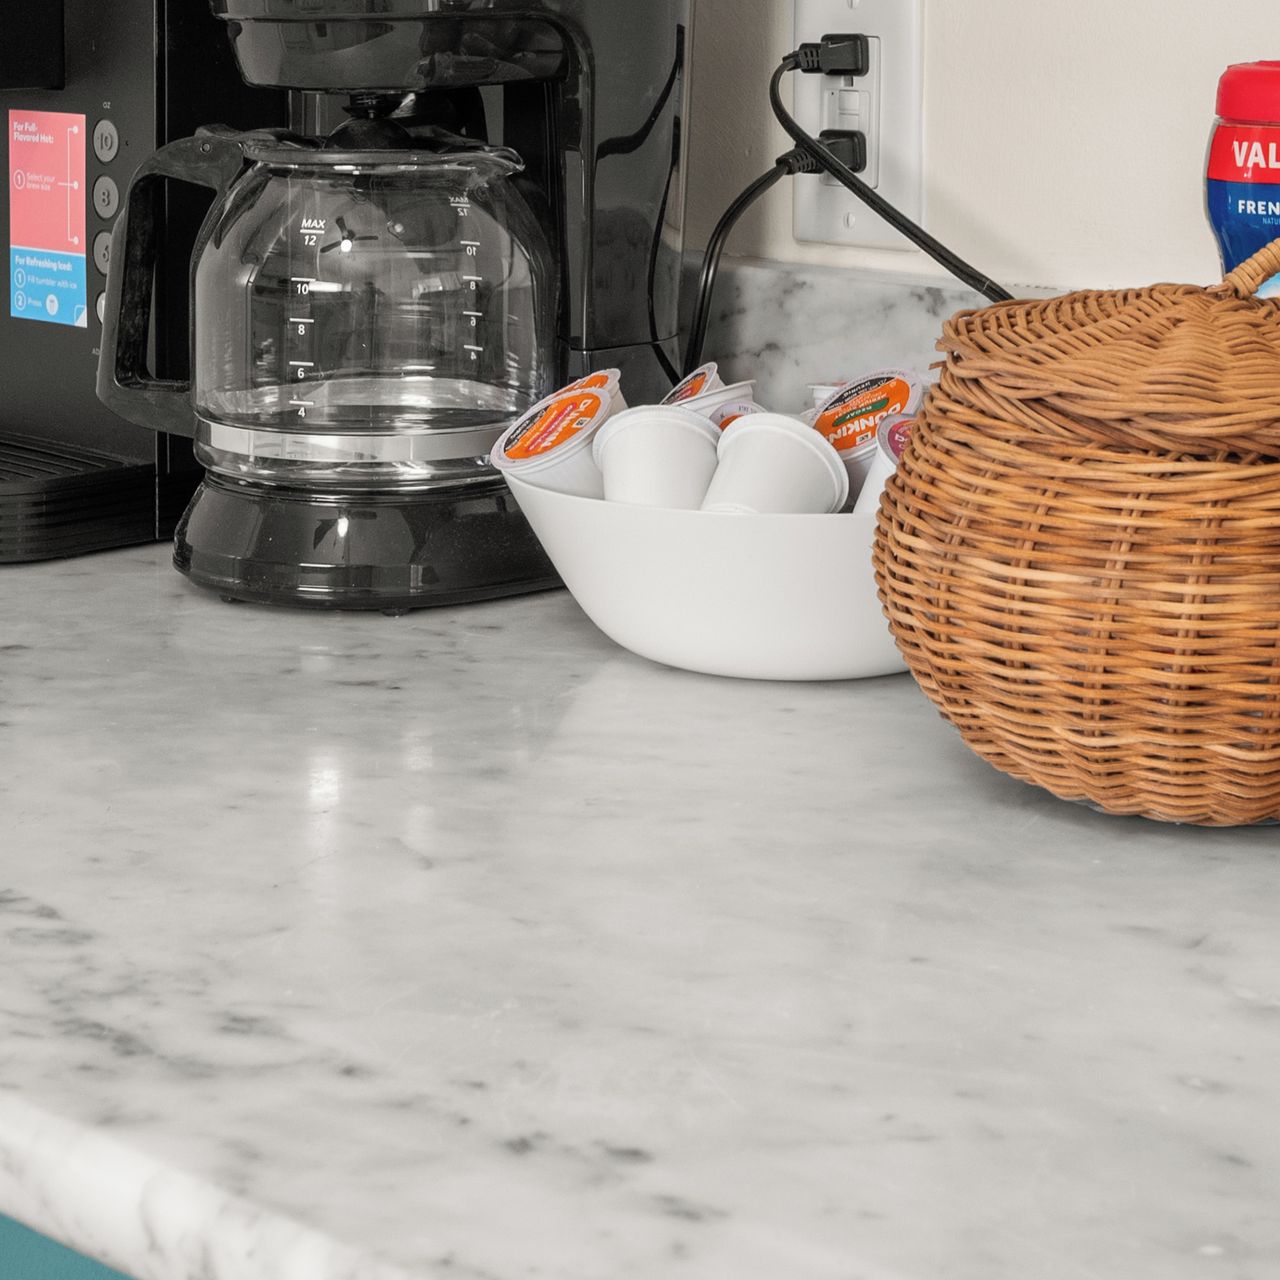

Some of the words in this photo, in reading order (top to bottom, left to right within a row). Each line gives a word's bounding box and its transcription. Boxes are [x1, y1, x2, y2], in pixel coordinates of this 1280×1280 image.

[13, 121, 24, 131] For
[14, 132, 39, 143] Flavored
[99, 132, 113, 151] 10
[102, 188, 110, 207] 8
[301, 218, 326, 229] MAX
[304, 235, 316, 246] 12
[15, 255, 25, 265] For
[296, 283, 309, 295] 10
[298, 324, 305, 335] 8
[297, 367, 305, 379] 6
[297, 407, 306, 418] 4
